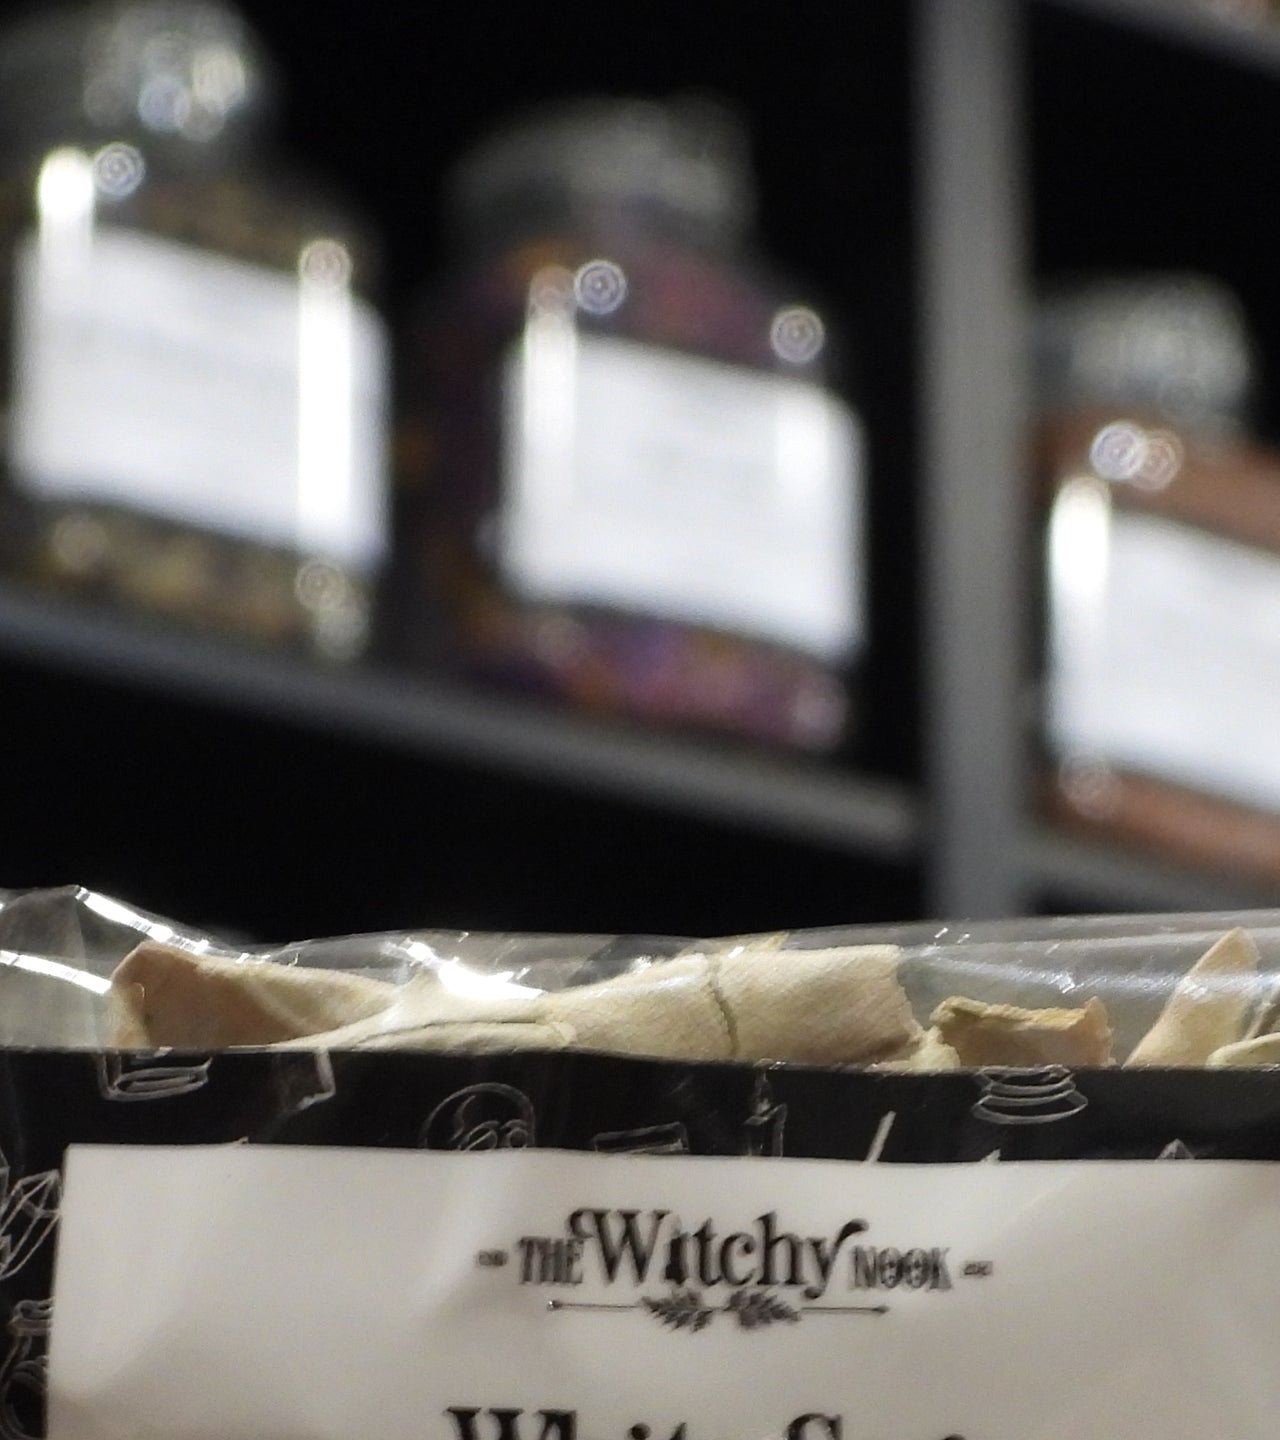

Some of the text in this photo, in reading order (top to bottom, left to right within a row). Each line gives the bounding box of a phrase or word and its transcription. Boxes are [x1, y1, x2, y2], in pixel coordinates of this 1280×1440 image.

[520, 1208, 953, 1300] THE Witchy NOOK
